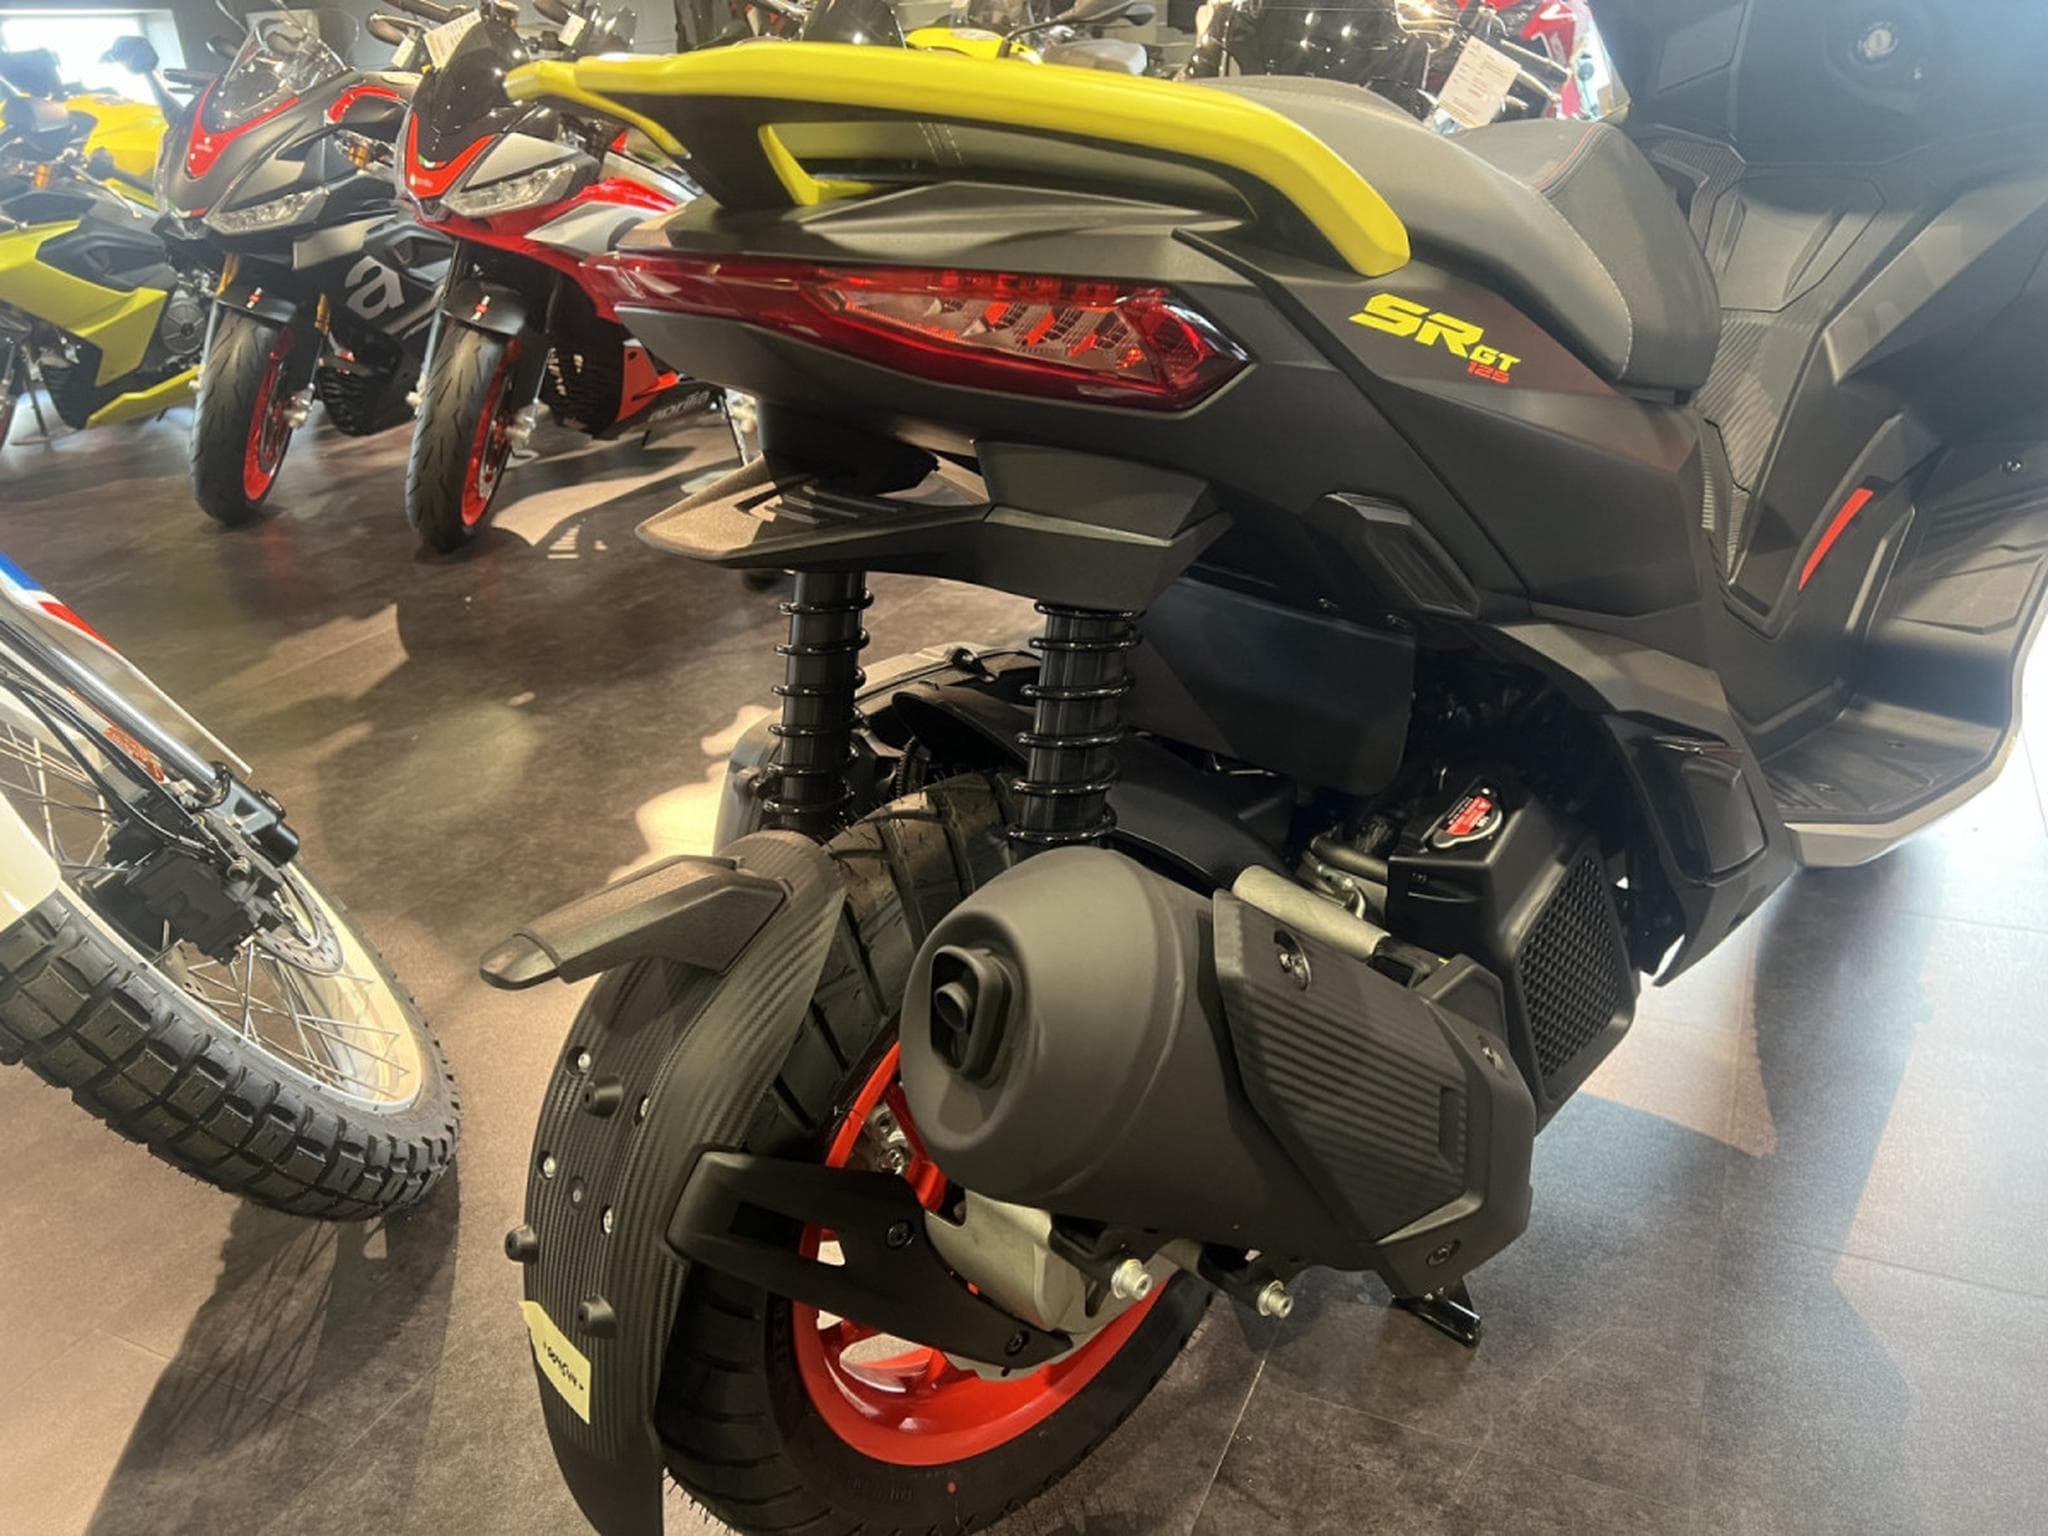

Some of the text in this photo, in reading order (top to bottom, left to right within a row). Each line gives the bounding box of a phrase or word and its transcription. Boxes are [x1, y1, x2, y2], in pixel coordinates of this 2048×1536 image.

[1348, 293, 1521, 371] SR GT
[1467, 361, 1510, 384] 125
